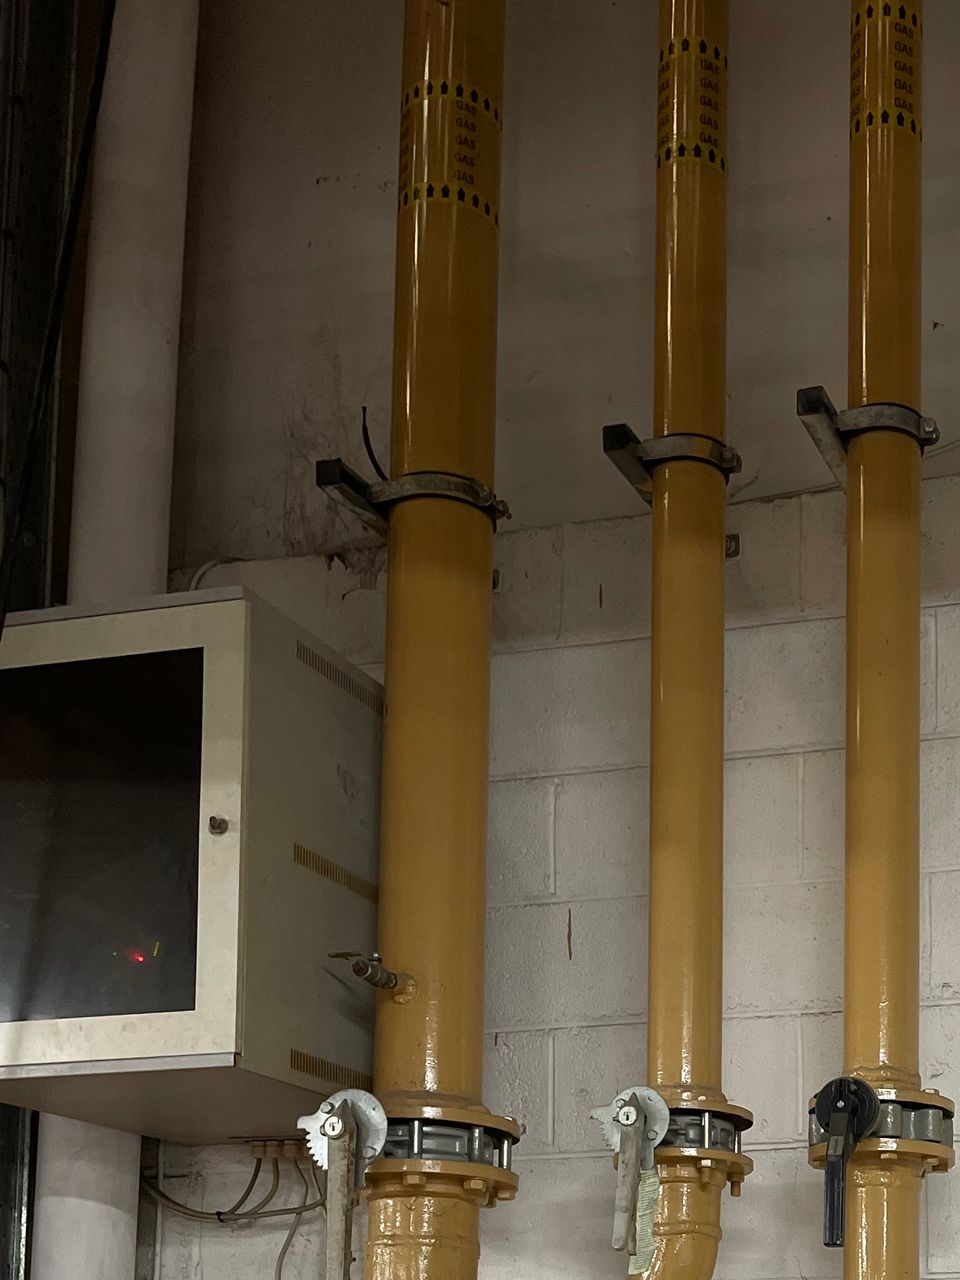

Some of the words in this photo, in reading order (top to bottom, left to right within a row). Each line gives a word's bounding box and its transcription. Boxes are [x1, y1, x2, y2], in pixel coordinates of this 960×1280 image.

[895, 22, 914, 40] GAS
[895, 40, 914, 58] GAS
[700, 59, 719, 76] GAS
[895, 60, 914, 77] GAS
[700, 77, 719, 94] GAS
[895, 78, 914, 95] GAS
[700, 95, 719, 112] GAS
[895, 97, 914, 114] GAS
[700, 114, 719, 131] GAS
[700, 132, 719, 148] GAS
